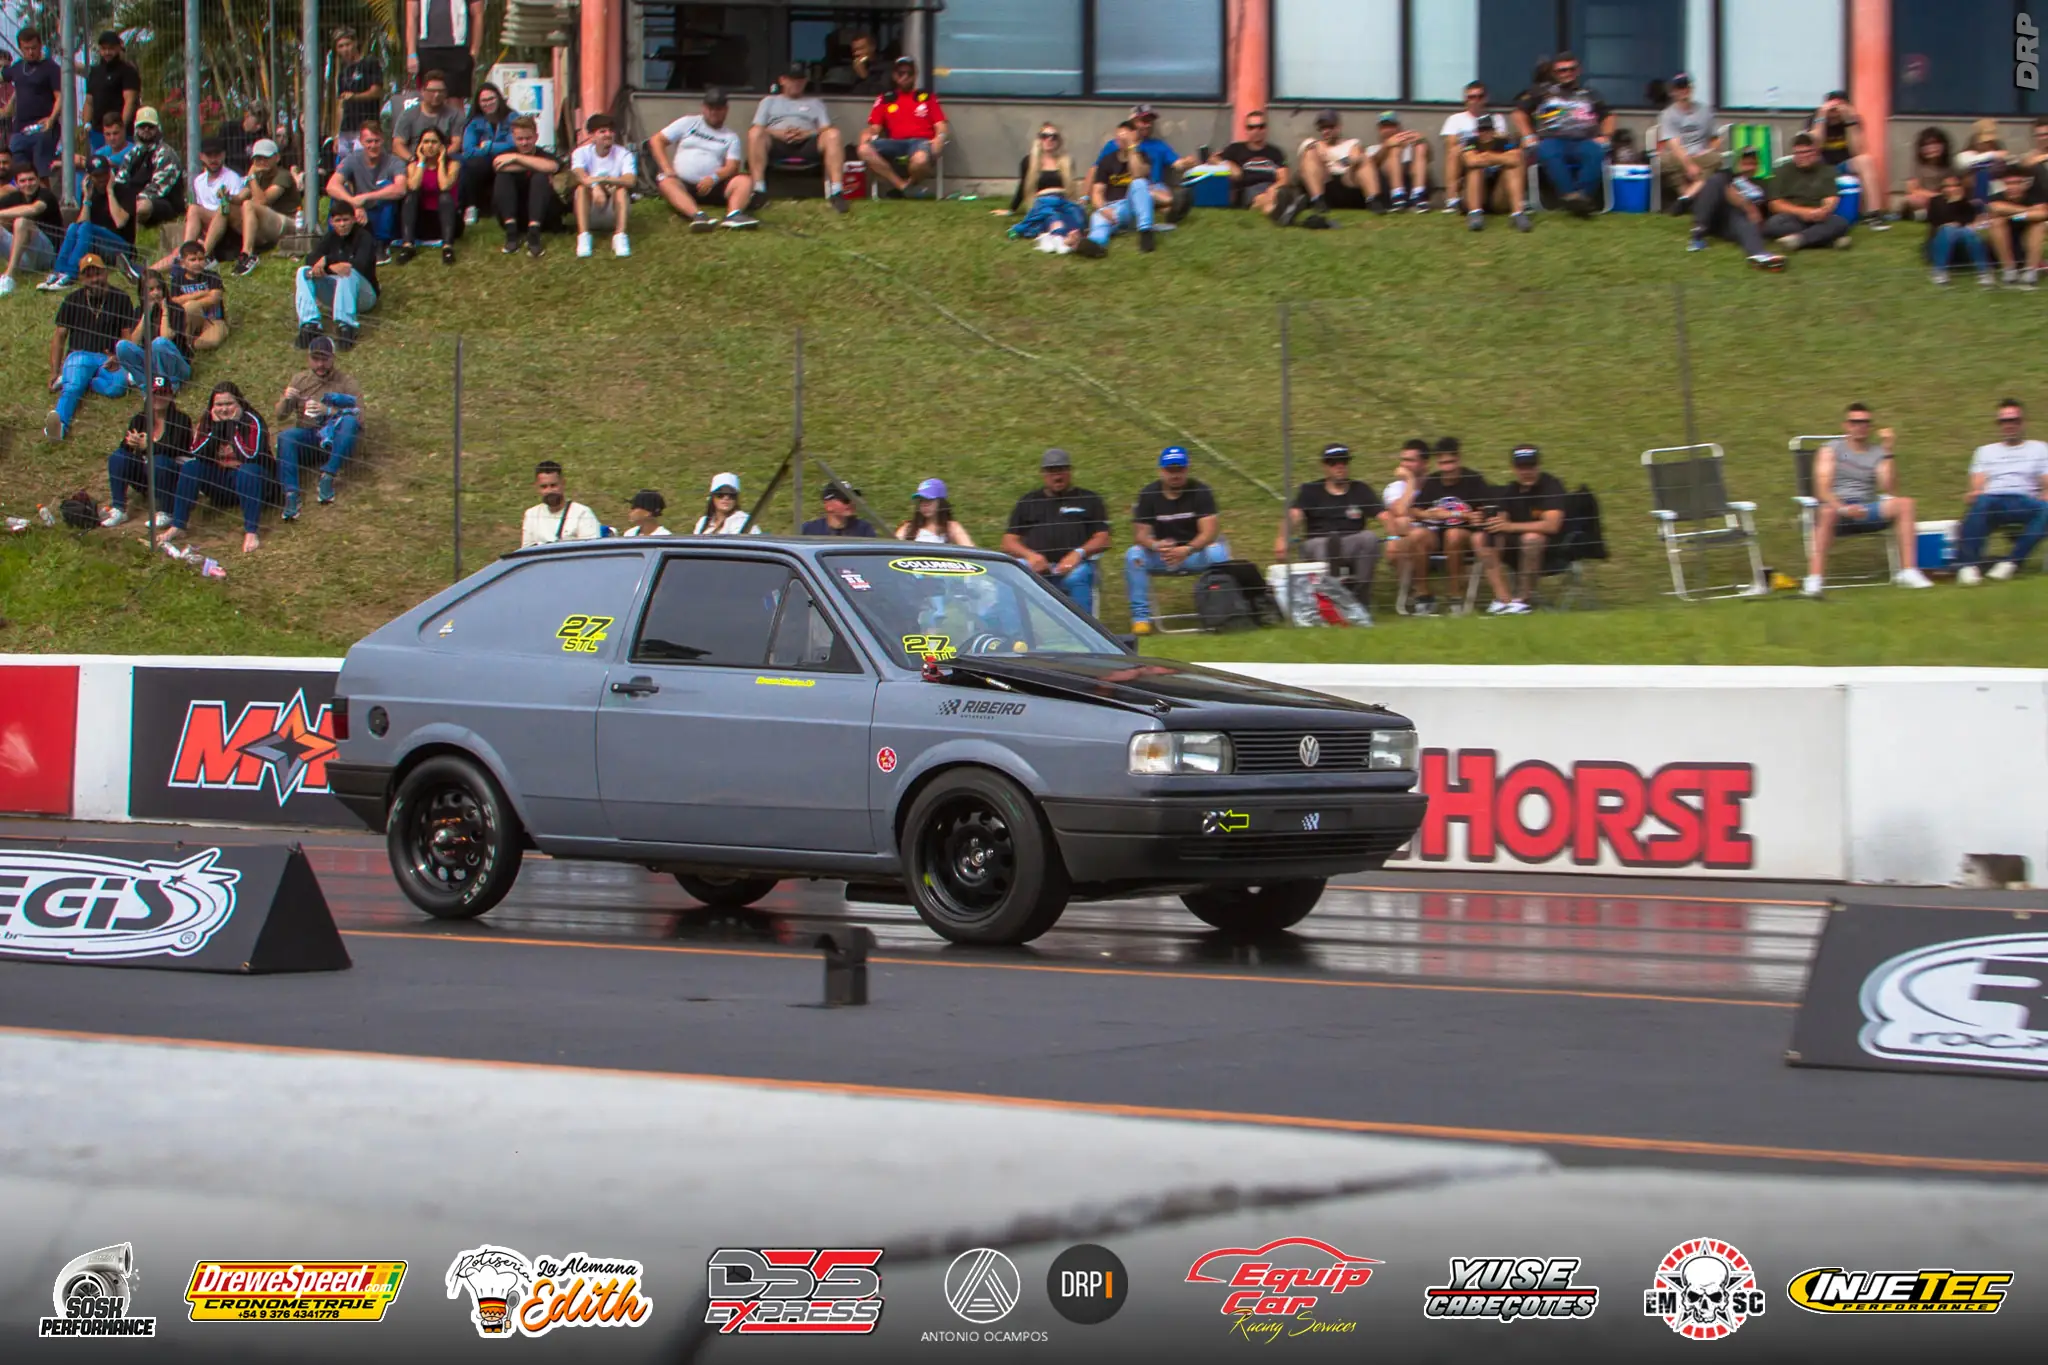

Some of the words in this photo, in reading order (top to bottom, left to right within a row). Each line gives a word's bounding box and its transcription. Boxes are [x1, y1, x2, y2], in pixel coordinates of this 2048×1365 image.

[896, 561, 977, 570] COLUMBIA
[557, 614, 614, 638] 27
[562, 638, 598, 652] STL
[903, 635, 950, 653] 27
[963, 701, 1026, 715] RIBEIRO
[1420, 748, 1753, 869] HORSE
